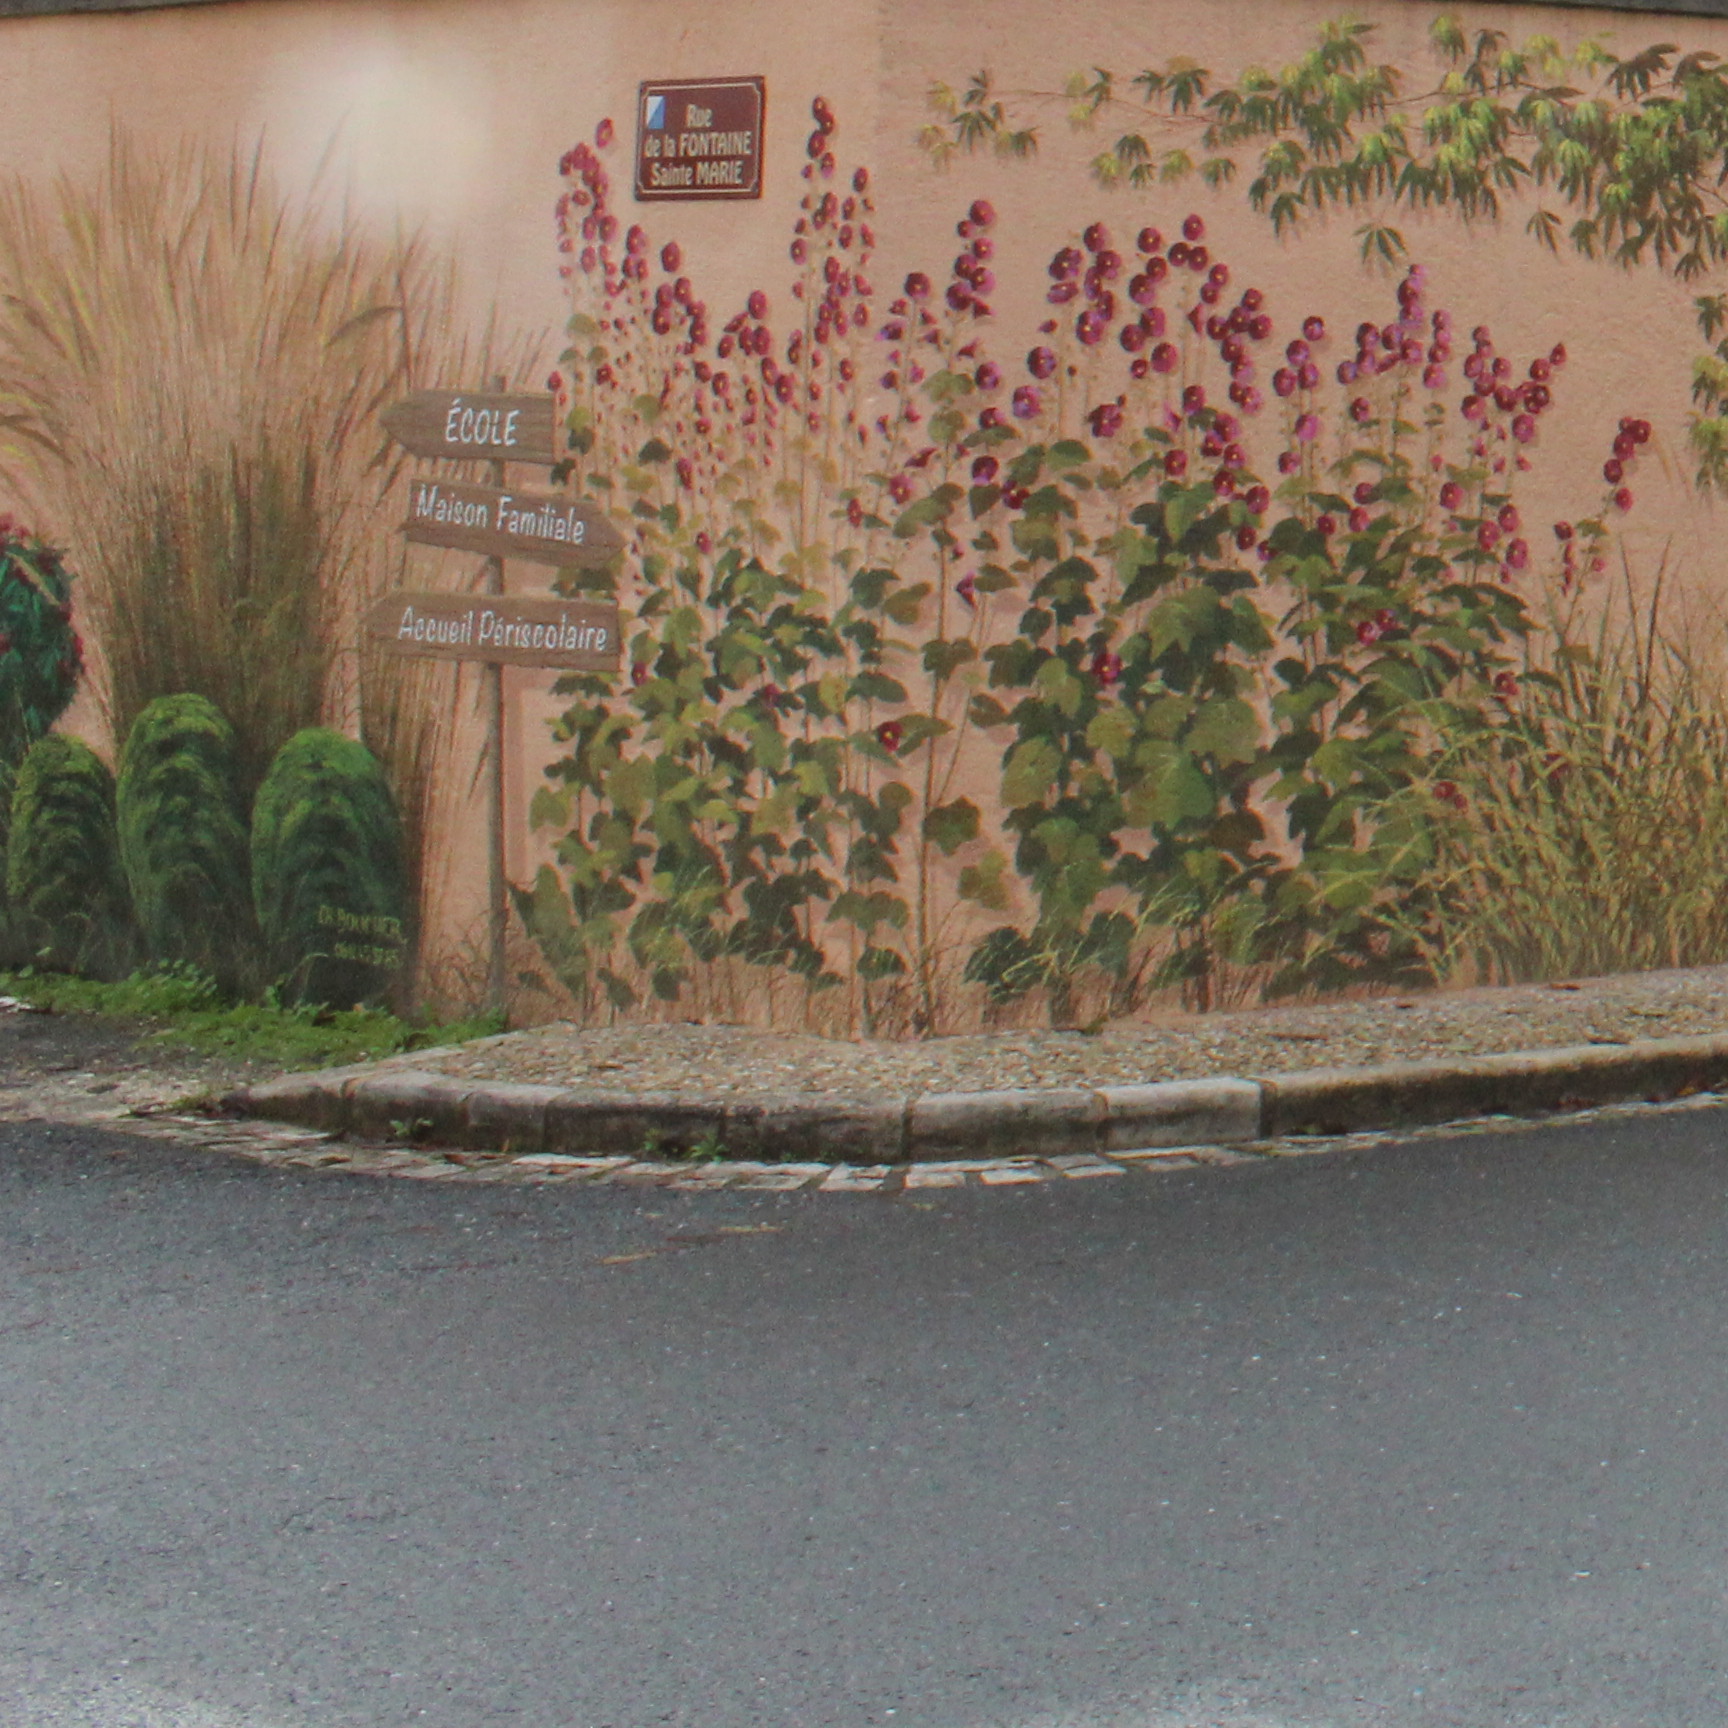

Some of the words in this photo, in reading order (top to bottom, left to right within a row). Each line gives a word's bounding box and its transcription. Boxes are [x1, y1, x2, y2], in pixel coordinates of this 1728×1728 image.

[687, 104, 713, 128] Rue
[645, 135, 661, 157] de
[665, 135, 676, 157] la
[680, 131, 752, 156] FONTAINE
[651, 161, 693, 186] Sainte
[697, 161, 743, 184] MARIE
[445, 397, 520, 447] ÉCOLE
[416, 483, 489, 529] Maison
[398, 605, 475, 645] Accueil
[478, 610, 608, 652] Périscolaire
